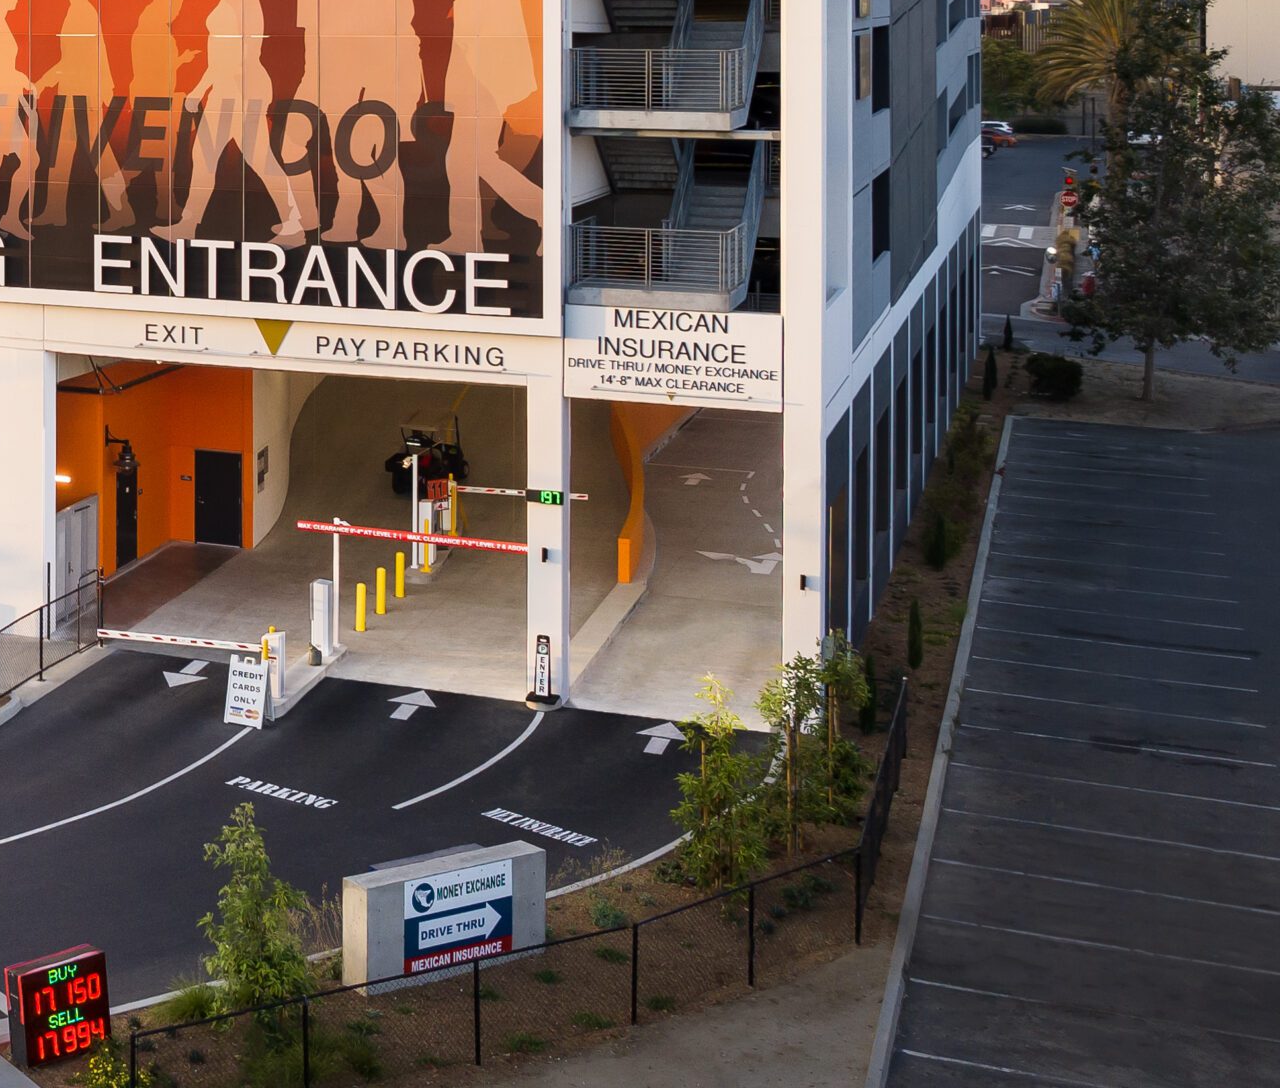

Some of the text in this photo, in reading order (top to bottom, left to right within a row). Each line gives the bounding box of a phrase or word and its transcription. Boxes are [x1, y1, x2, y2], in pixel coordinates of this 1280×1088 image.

[93, 234, 511, 316] ENTRANCE
[614, 309, 729, 334] MEXICAN
[145, 323, 204, 345] EXIT
[316, 336, 505, 367] PAY PARKING
[598, 336, 747, 364] INSURANCE
[568, 357, 606, 370] DRIVE
[609, 360, 644, 372] THRU
[654, 363, 702, 376] MONEY
[705, 367, 779, 381] EXCHANGE
[635, 376, 663, 389] MAX
[665, 378, 745, 394] CLEARANCE
[540, 491, 561, 504] 197
[313, 524, 349, 533] CLEARANCE
[373, 530, 392, 538] LEVEL
[423, 536, 460, 545] CLEARANCE
[476, 541, 495, 549] LEVEL
[232, 669, 264, 680] CREDIT
[232, 682, 261, 693] CARDS
[233, 695, 257, 705] ONLY
[224, 775, 339, 809] PARKING
[481, 808, 598, 847] MEX INSURANCE
[436, 873, 506, 901] MONEY EXCHANGE
[421, 917, 486, 941] DRIVE THRU
[411, 941, 503, 972] MEXICAN INSURANCE
[48, 964, 78, 984] BUY
[48, 1007, 84, 1029] SELL
